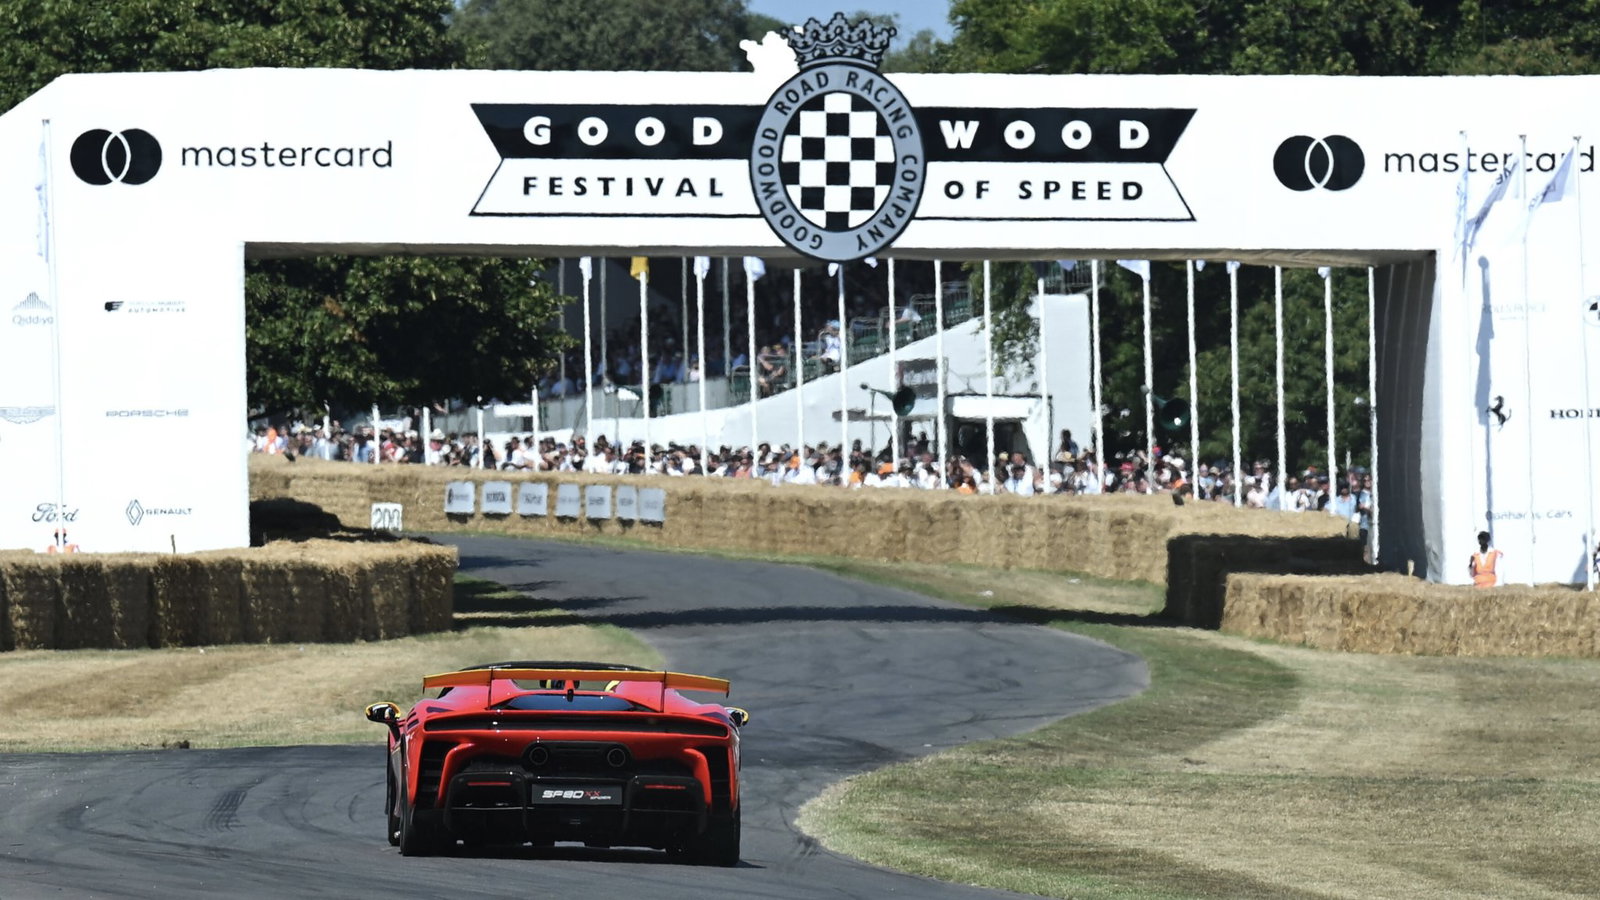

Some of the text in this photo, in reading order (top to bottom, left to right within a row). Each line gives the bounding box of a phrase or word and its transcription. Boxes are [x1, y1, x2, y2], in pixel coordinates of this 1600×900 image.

[523, 115, 1150, 150] GOOD WOOD
[182, 140, 393, 168] mastercard
[758, 71, 918, 251] GOODWOOD ROAD RACING COMPANY
[1385, 146, 1594, 172] masterad
[523, 177, 1143, 200] FESTIVAL OF SPEED
[106, 408, 189, 418] PORSCHE
[145, 508, 193, 516] RENAULT
